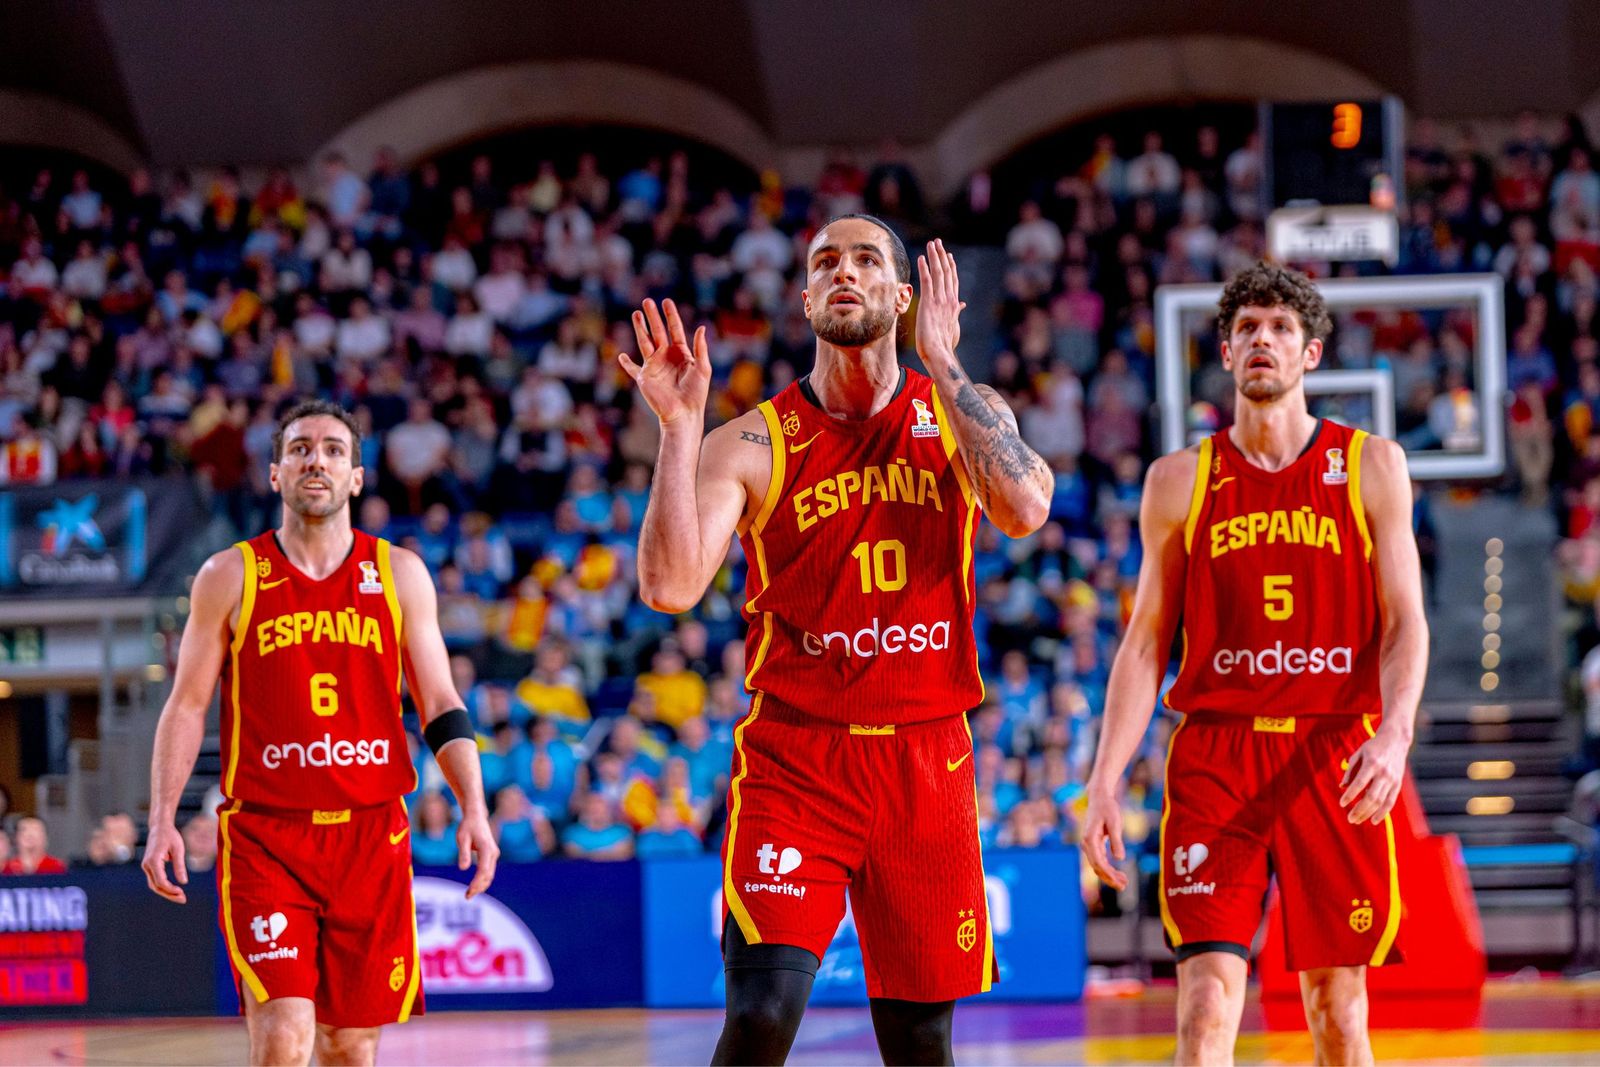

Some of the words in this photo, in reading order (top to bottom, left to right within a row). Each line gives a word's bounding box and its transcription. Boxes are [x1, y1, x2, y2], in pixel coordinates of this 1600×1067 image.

[793, 458, 942, 533] ESPAÑA
[1210, 505, 1342, 558] ESPAÑA
[851, 539, 907, 594] 10
[1263, 575, 1294, 621] 5
[257, 607, 384, 657] ESPAÑA
[803, 618, 951, 658] endesa
[1213, 641, 1352, 675] endesa
[309, 672, 339, 717] 6
[262, 732, 390, 769] endesa
